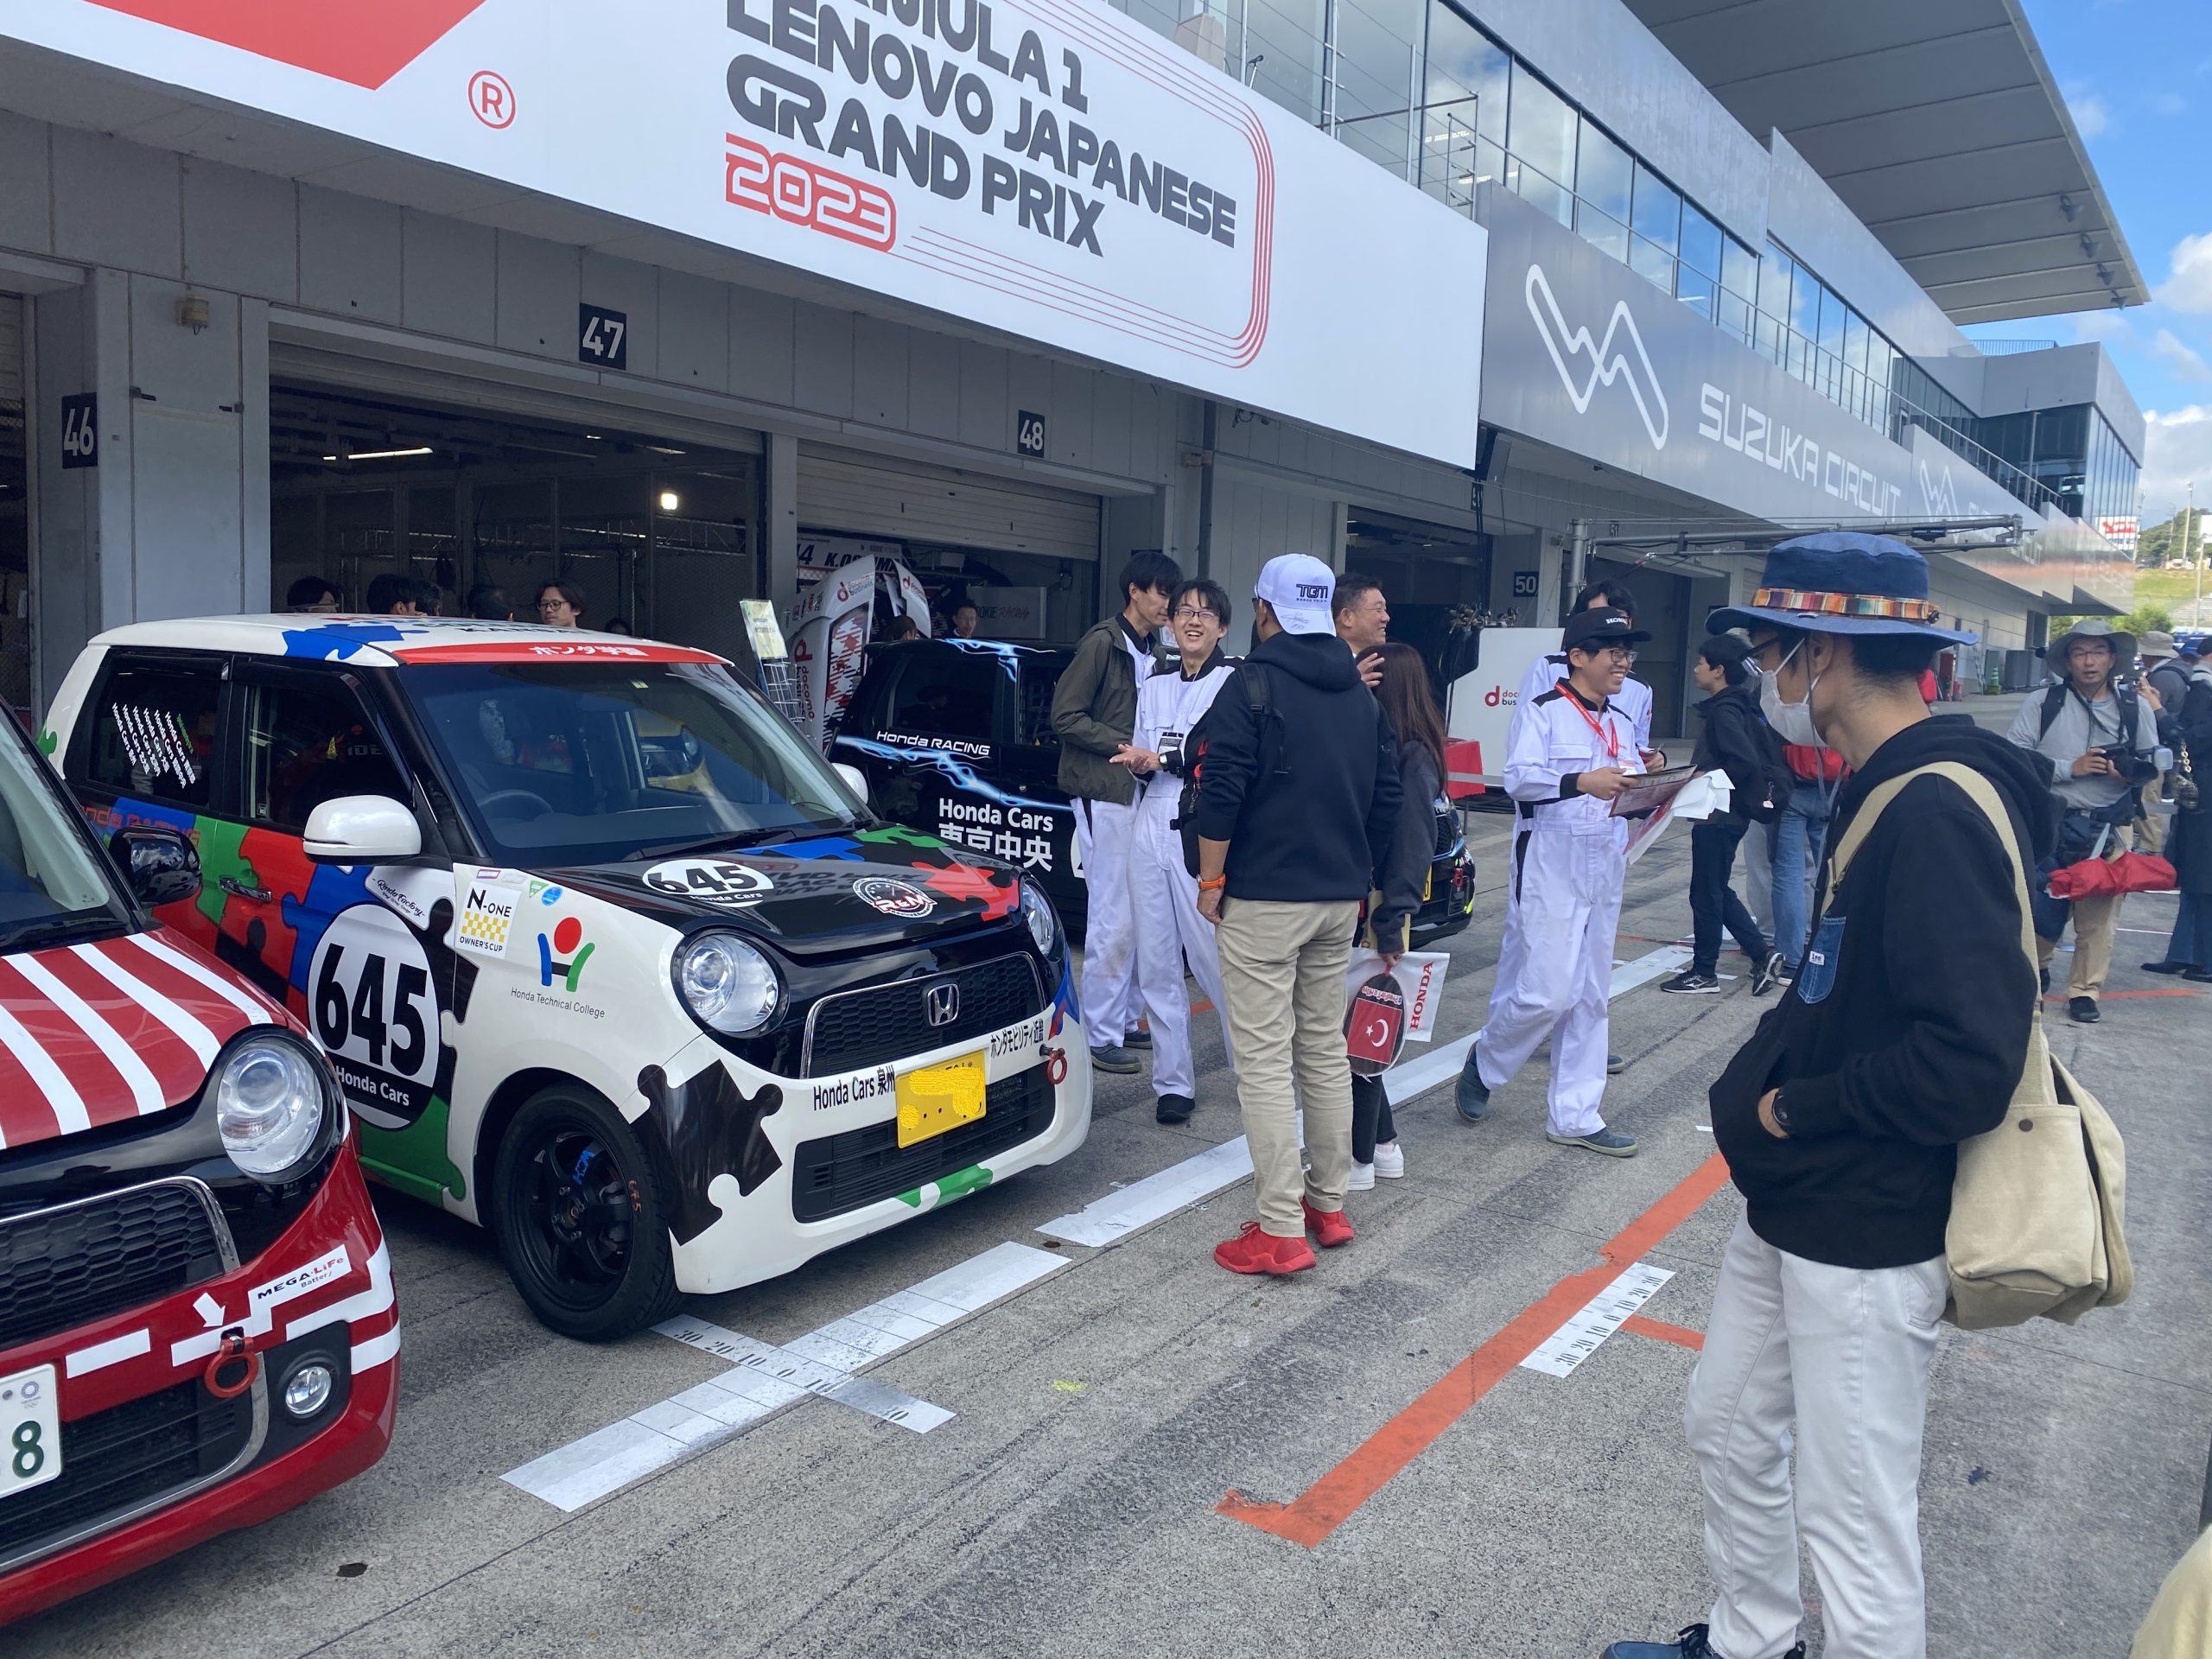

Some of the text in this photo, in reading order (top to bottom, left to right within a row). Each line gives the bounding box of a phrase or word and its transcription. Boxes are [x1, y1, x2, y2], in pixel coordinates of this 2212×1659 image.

[1062, 48, 1089, 115] 1
[727, 0, 1236, 250] LENOVO JAPANESE
[727, 54, 1106, 257] GRAND PRIX
[726, 132, 897, 252] 2023
[582, 317, 625, 360] 47
[63, 406, 94, 457] 46
[1020, 420, 1045, 451] 48
[1699, 382, 1901, 523] SUZUKA CIRCUIT
[1515, 575, 1537, 594] 50
[1502, 690, 1521, 698] doc
[876, 730, 991, 756] Honda RACING
[939, 798, 1053, 833] Honda Cars
[939, 822, 1053, 873] 東京中央
[648, 865, 758, 893] 645
[734, 892, 764, 900] Cars
[467, 887, 512, 918] N-ONE
[489, 943, 503, 952] CUP
[315, 943, 428, 1077] 645
[511, 988, 606, 1019] Honda Technical College
[1410, 962, 1434, 1030] HONDA
[334, 1065, 410, 1107] Honda Cars
[813, 1084, 849, 1111] Honda
[852, 1077, 875, 1102] Cars
[11, 1420, 45, 1478] 8
